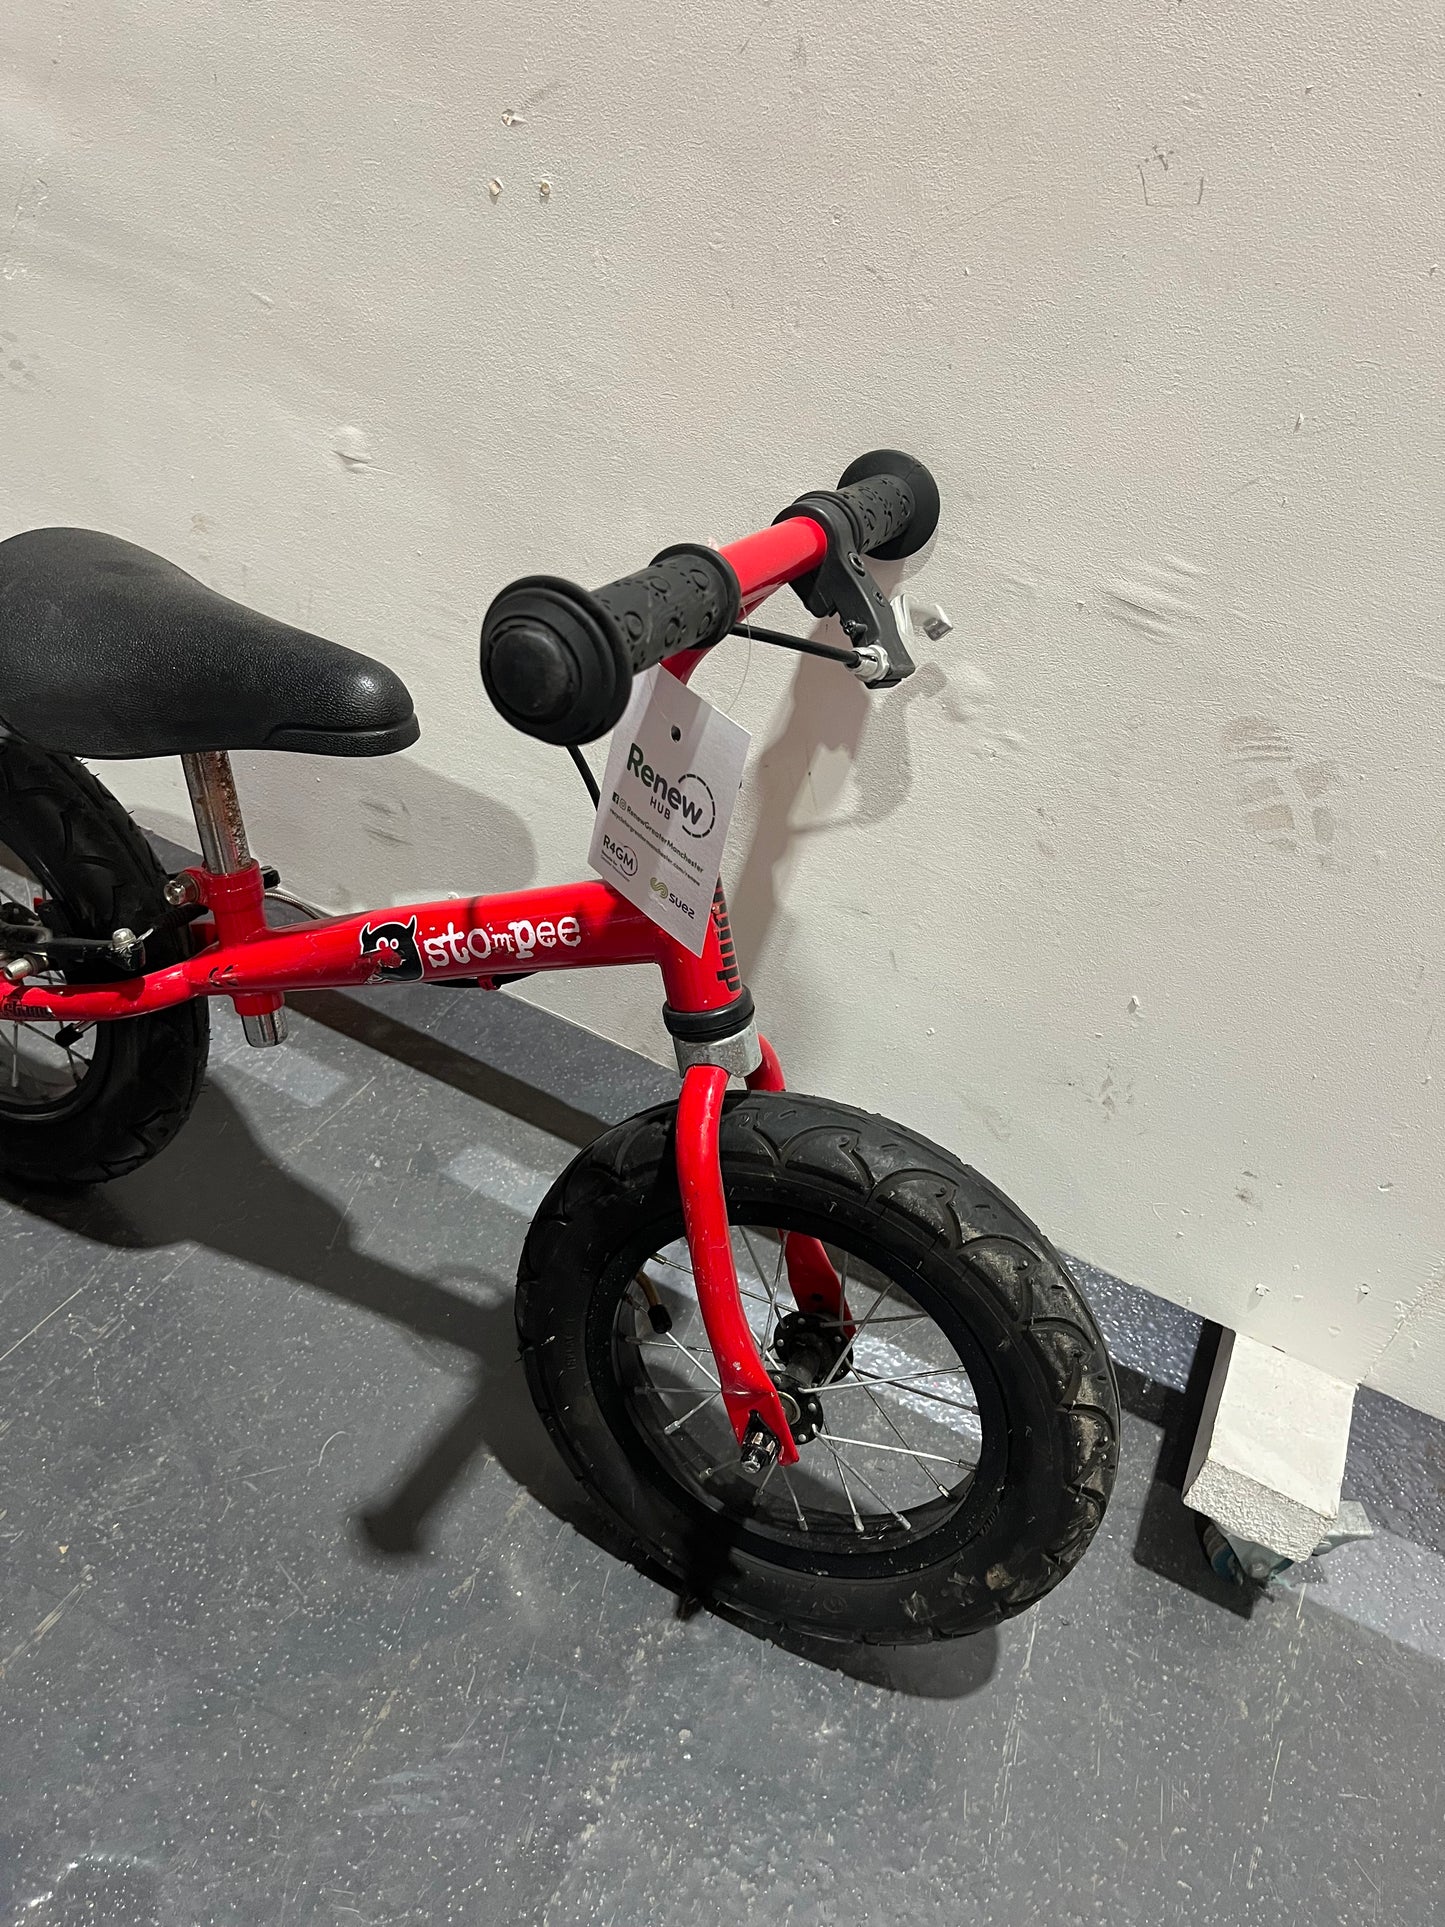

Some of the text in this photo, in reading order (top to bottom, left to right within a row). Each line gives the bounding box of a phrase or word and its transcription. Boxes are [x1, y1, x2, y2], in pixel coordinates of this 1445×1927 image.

[627, 743, 703, 825] Renew
[649, 796, 671, 820] HUB
[603, 834, 633, 871] R4GM
[626, 806, 704, 873] RenewGreaterManchester
[668, 893, 695, 919] suez
[424, 916, 582, 968] stompee
